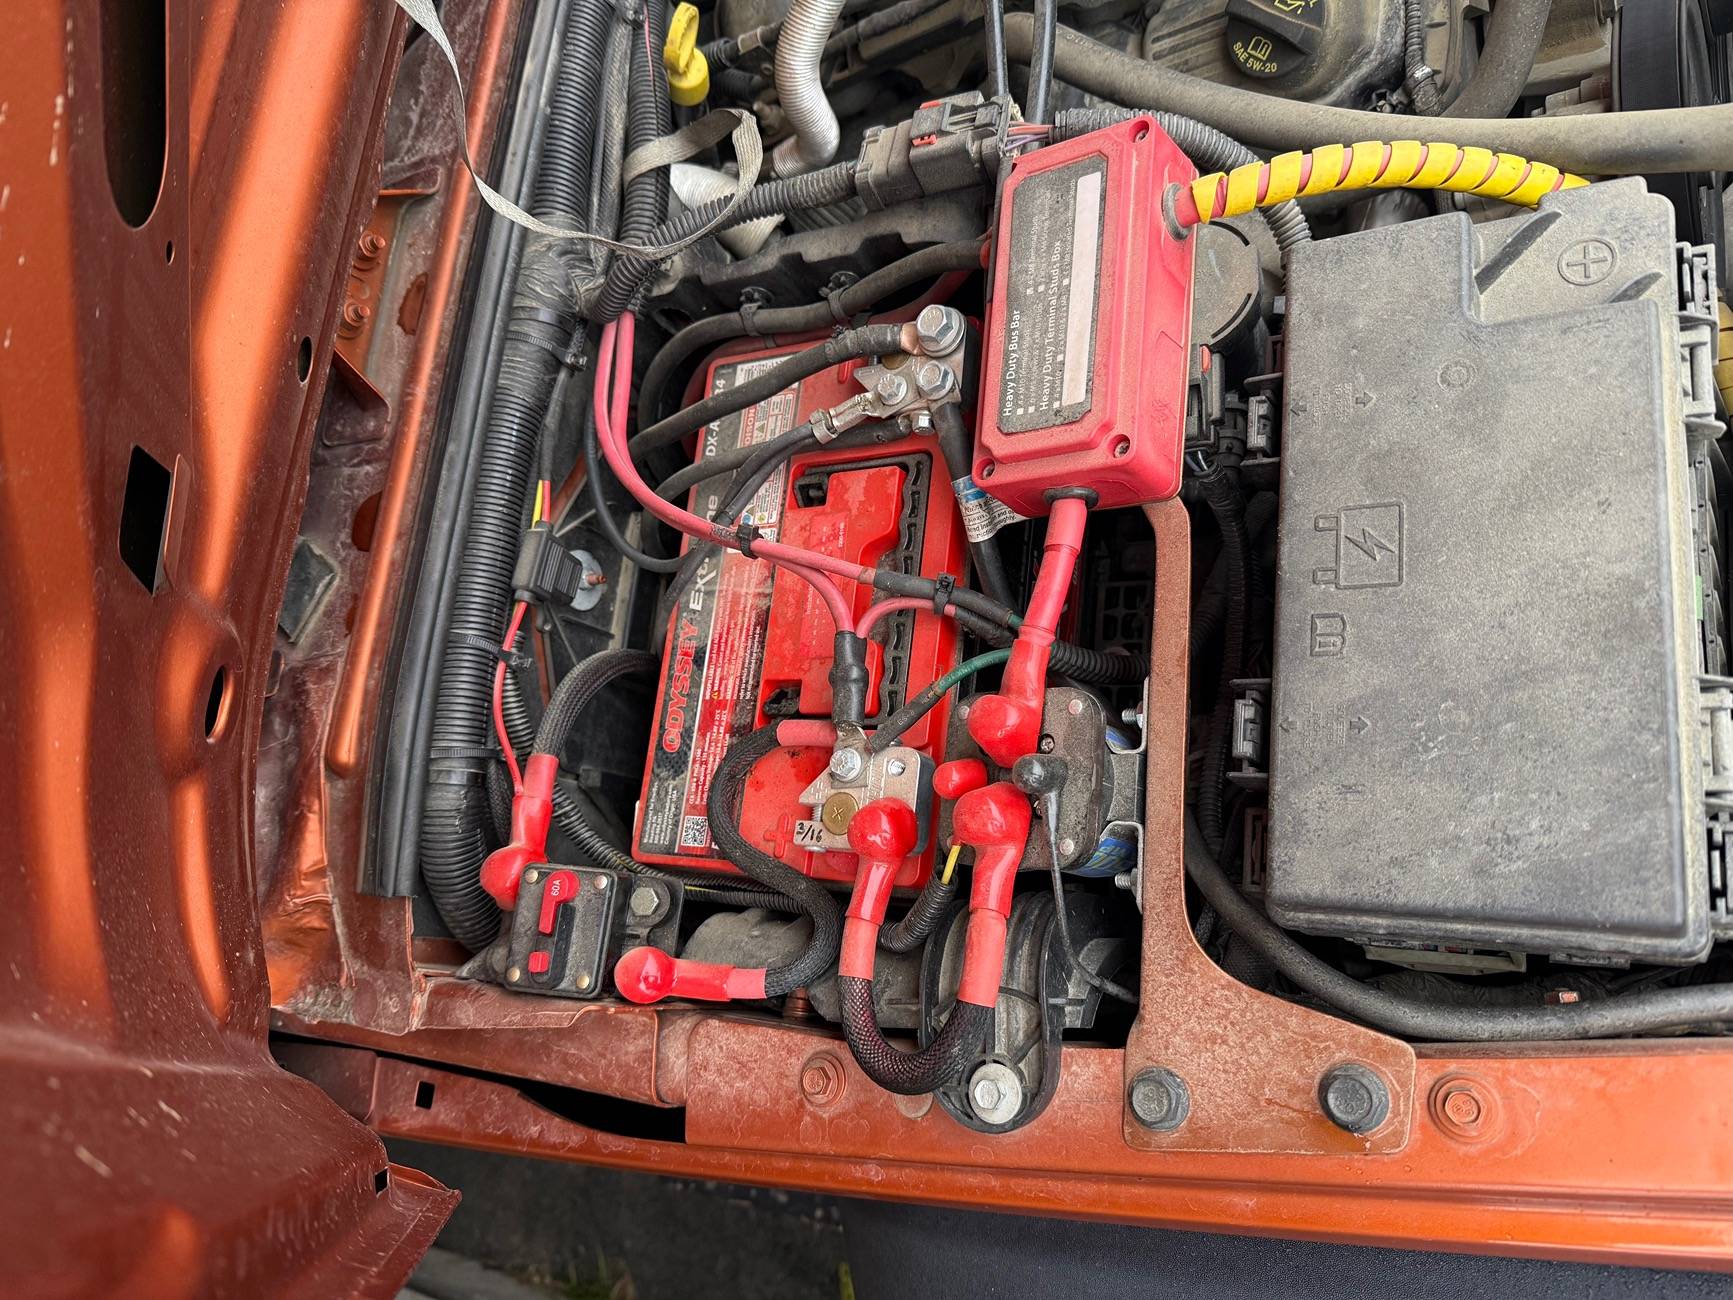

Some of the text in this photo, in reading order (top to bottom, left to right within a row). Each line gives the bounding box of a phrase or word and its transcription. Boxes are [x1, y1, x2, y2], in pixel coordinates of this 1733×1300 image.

[1233, 41, 1277, 73] SAE 5W-20
[1052, 239, 1060, 259] Box
[1049, 263, 1059, 292] Studs
[1044, 294, 1056, 344] Terminal
[1003, 309, 1020, 416] Heavy Duty Bus Bar
[1042, 345, 1054, 373] Duty
[1040, 375, 1051, 410] Heavy
[662, 621, 699, 753] ODYSSEY
[697, 764, 706, 784] Capacity
[703, 773, 711, 791] Charge
[550, 878, 562, 897] 60A
